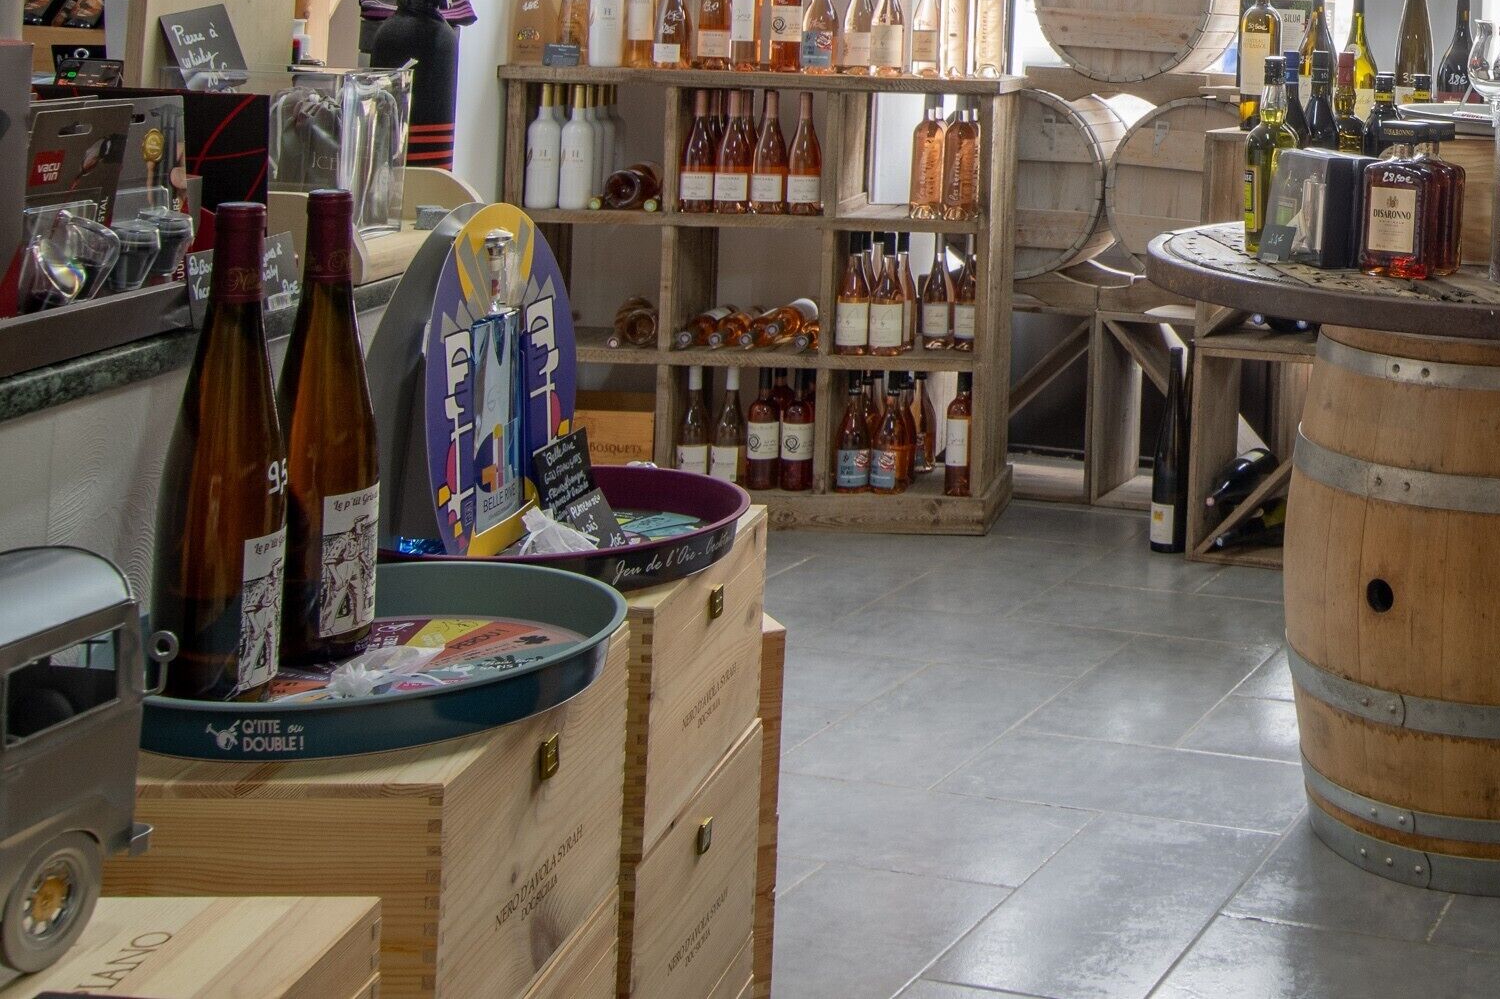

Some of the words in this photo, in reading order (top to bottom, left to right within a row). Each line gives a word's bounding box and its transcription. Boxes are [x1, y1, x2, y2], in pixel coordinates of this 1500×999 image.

[1383, 128, 1414, 137] DISARONNO
[37, 162, 61, 174] vacu
[43, 171, 58, 182] vin
[98, 196, 109, 222] STAL
[1373, 209, 1411, 220] DISARONNO
[483, 494, 504, 512] BELLE
[505, 484, 517, 502] RIVE
[612, 559, 641, 585] Jeu
[645, 555, 662, 572] de
[665, 545, 696, 567] l'Oie
[242, 719, 281, 736] Q'ITTE
[287, 723, 304, 735] ou
[243, 735, 296, 752] DOUBLE
[495, 896, 520, 931] NERO
[519, 860, 558, 901] D'AVOLA
[556, 824, 584, 864] SYRAH
[76, 931, 172, 990] IANO
[667, 945, 686, 975] NERO
